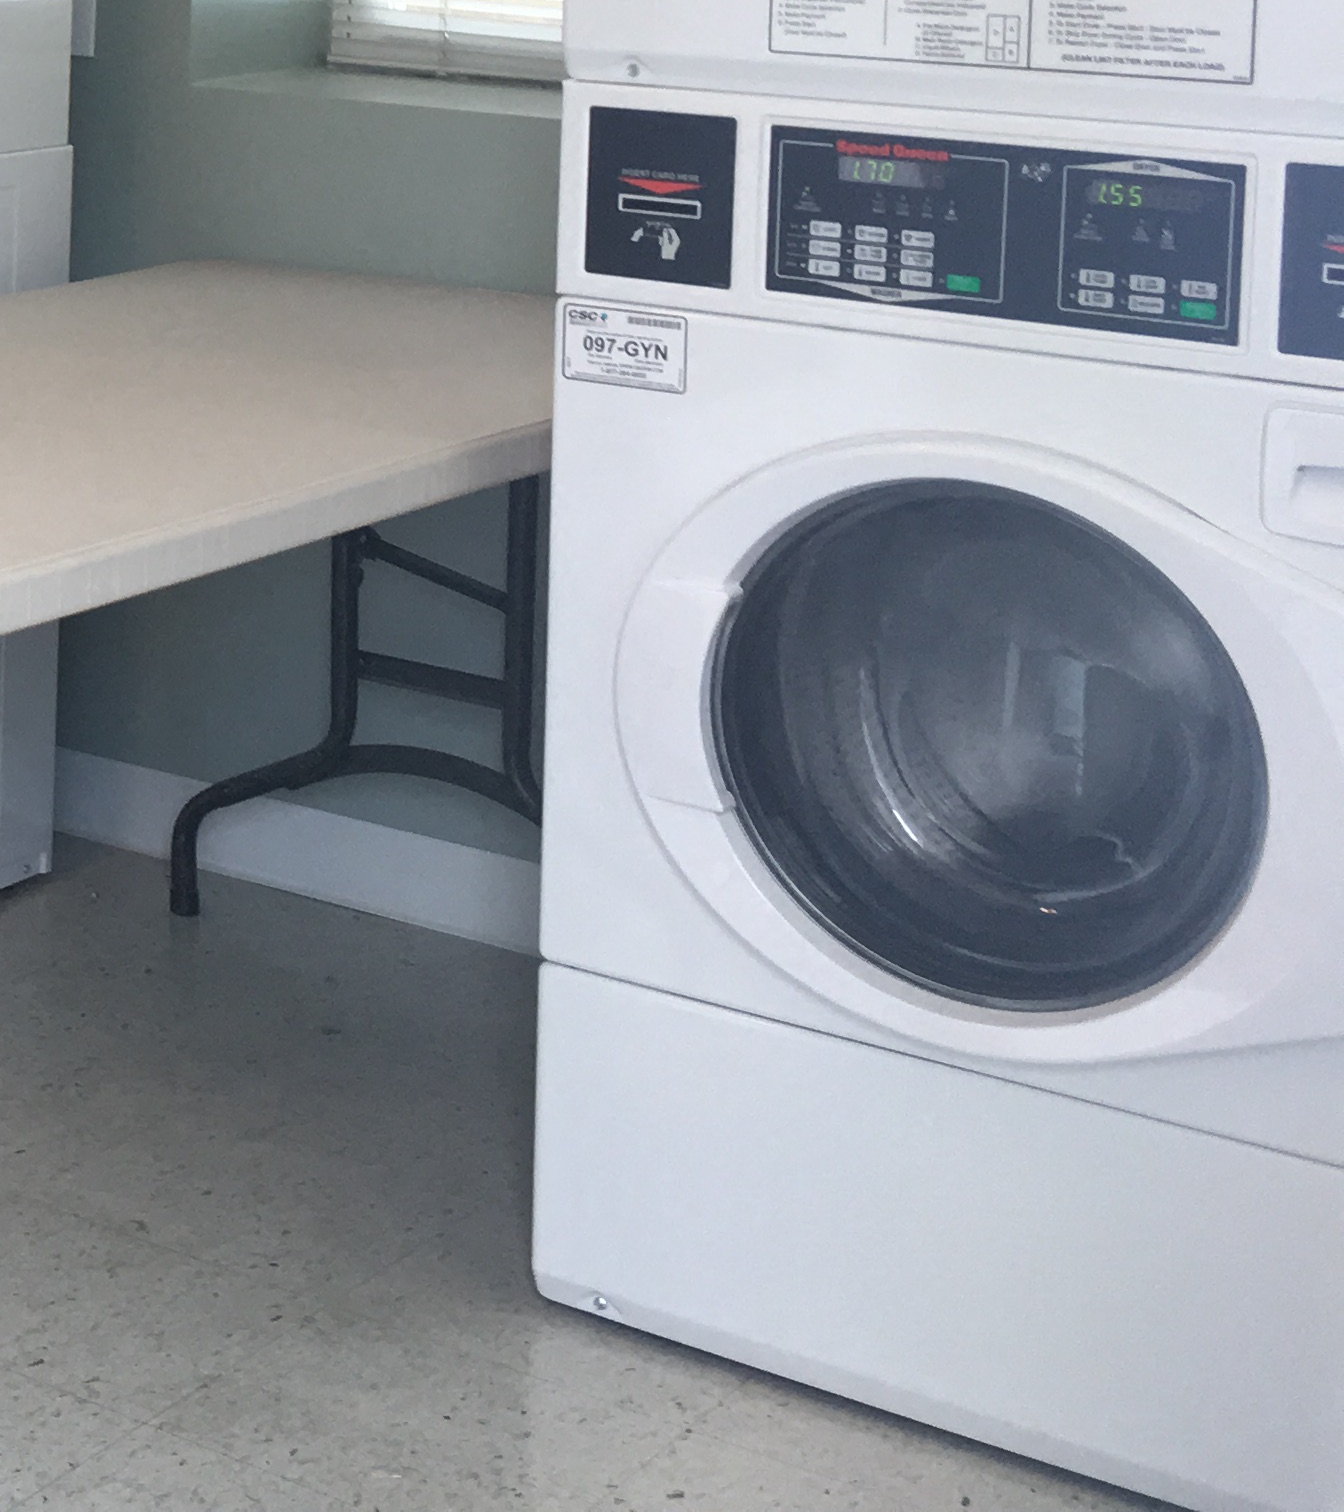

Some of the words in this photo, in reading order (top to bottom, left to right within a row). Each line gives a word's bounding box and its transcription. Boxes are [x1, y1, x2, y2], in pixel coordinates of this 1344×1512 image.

[835, 139, 891, 157] Speed
[893, 144, 950, 161] Queen
[621, 168, 650, 178] INSERT
[652, 171, 676, 180] CARD
[679, 173, 700, 183] HERE
[568, 309, 598, 321] CSC
[583, 335, 669, 361] 097-GYN
